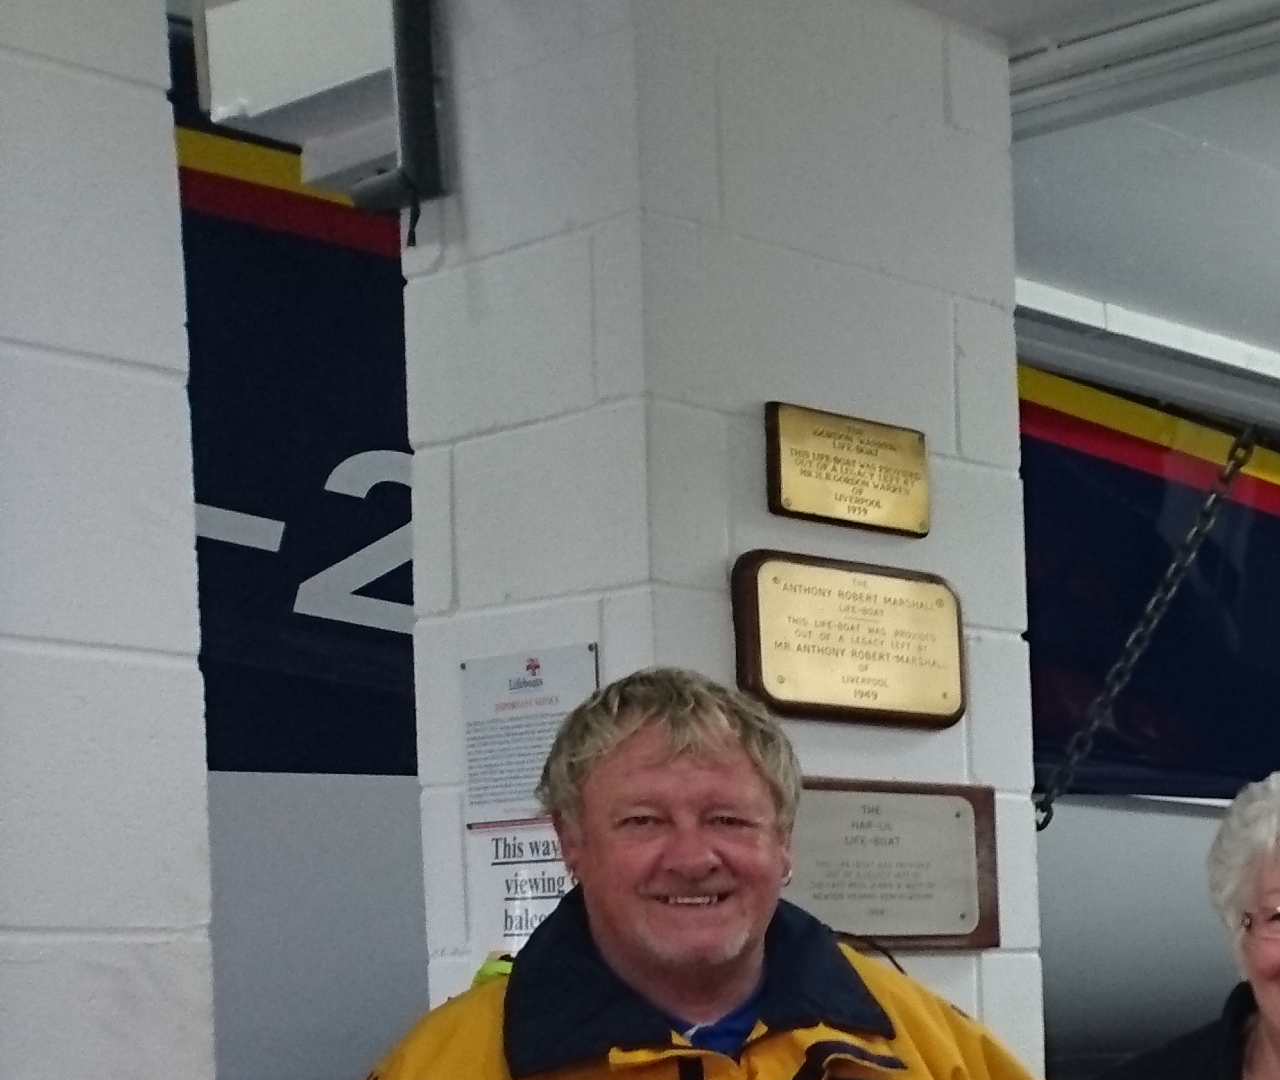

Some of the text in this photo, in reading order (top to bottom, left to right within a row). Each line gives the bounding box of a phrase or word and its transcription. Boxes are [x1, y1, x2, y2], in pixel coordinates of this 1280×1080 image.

[789, 447, 809, 459] THIS
[835, 492, 882, 510] LIVERPOOL
[782, 582, 935, 611] ANTHONY ROBERT MARSHALL
[839, 603, 884, 617] LIFE-BOAT
[787, 615, 937, 644] THIS LIFE-BOAT WAS PROVIDED
[794, 628, 813, 639] OUT
[819, 632, 831, 642] OF
[851, 636, 885, 648] LEGACY
[890, 640, 910, 651] LEFT
[796, 643, 846, 658] ANTHONY
[858, 662, 869, 672] OF
[841, 675, 889, 688] LIVERPOOL
[853, 689, 878, 701] 1949
[861, 804, 881, 815] THE
[491, 836, 524, 860] This
[844, 835, 900, 847] LIFE-BOAT
[505, 871, 566, 897] viewing
